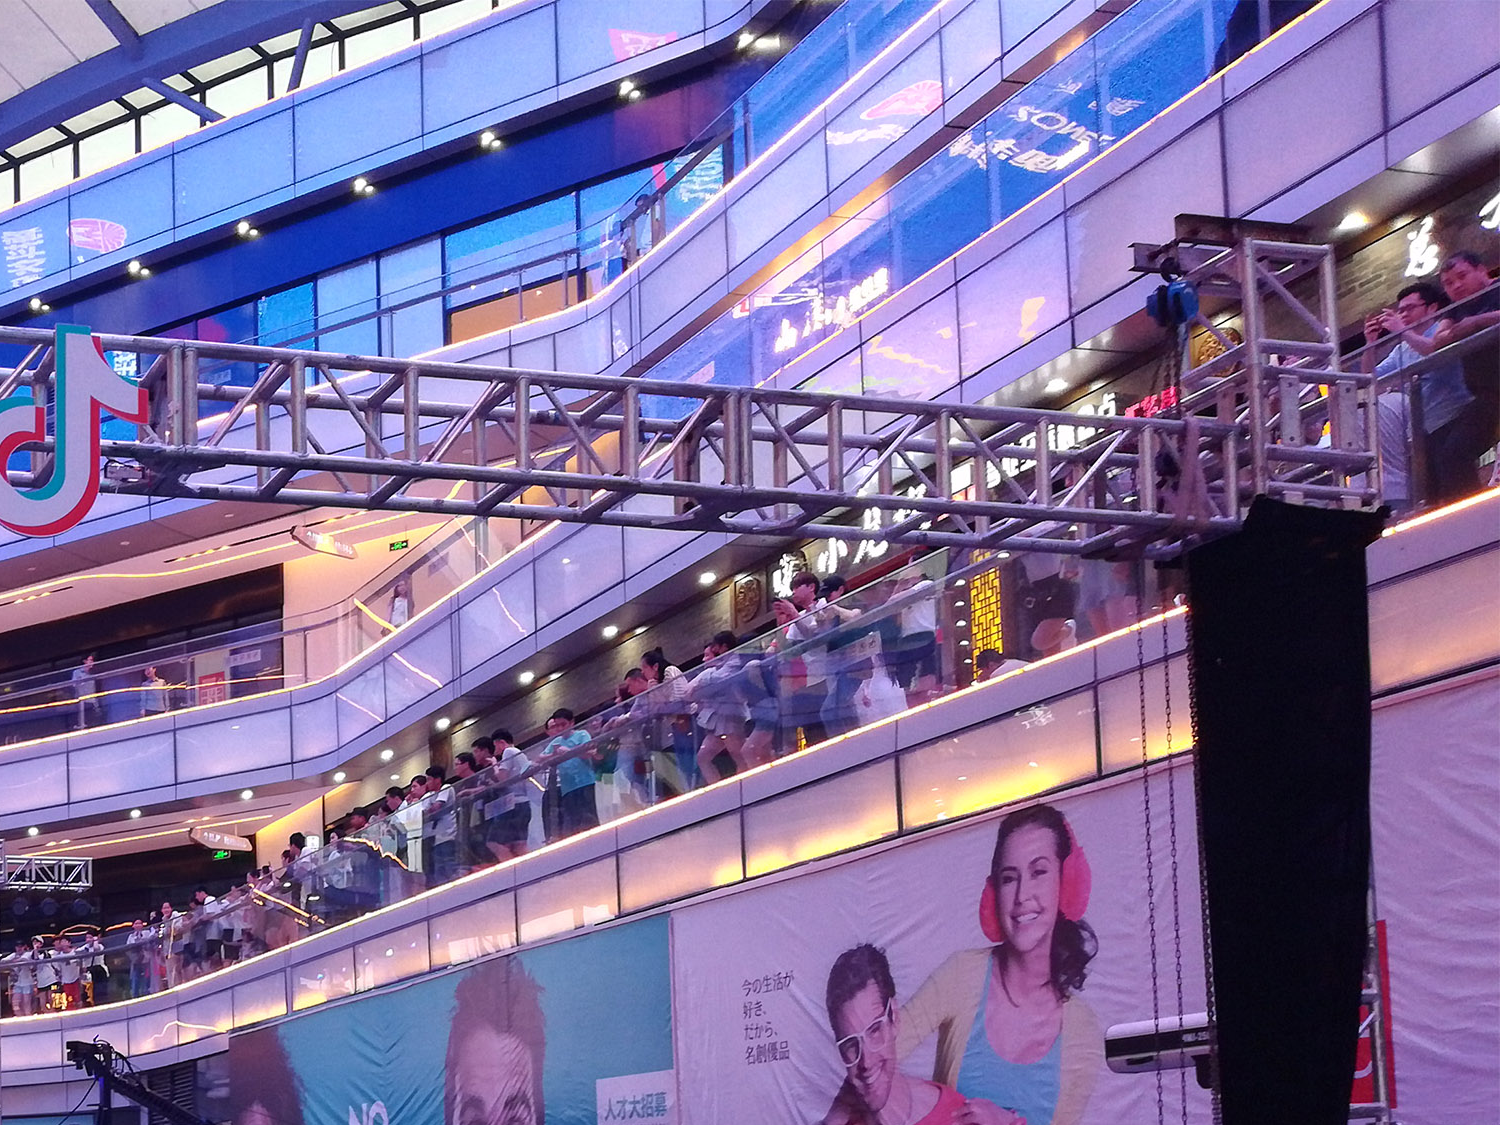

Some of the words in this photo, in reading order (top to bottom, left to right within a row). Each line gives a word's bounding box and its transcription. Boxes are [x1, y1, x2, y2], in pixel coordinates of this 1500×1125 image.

[741, 970, 794, 996] 今の生活が
[745, 1040, 790, 1065] 名創優品
[604, 1092, 667, 1121] 人才大招募
